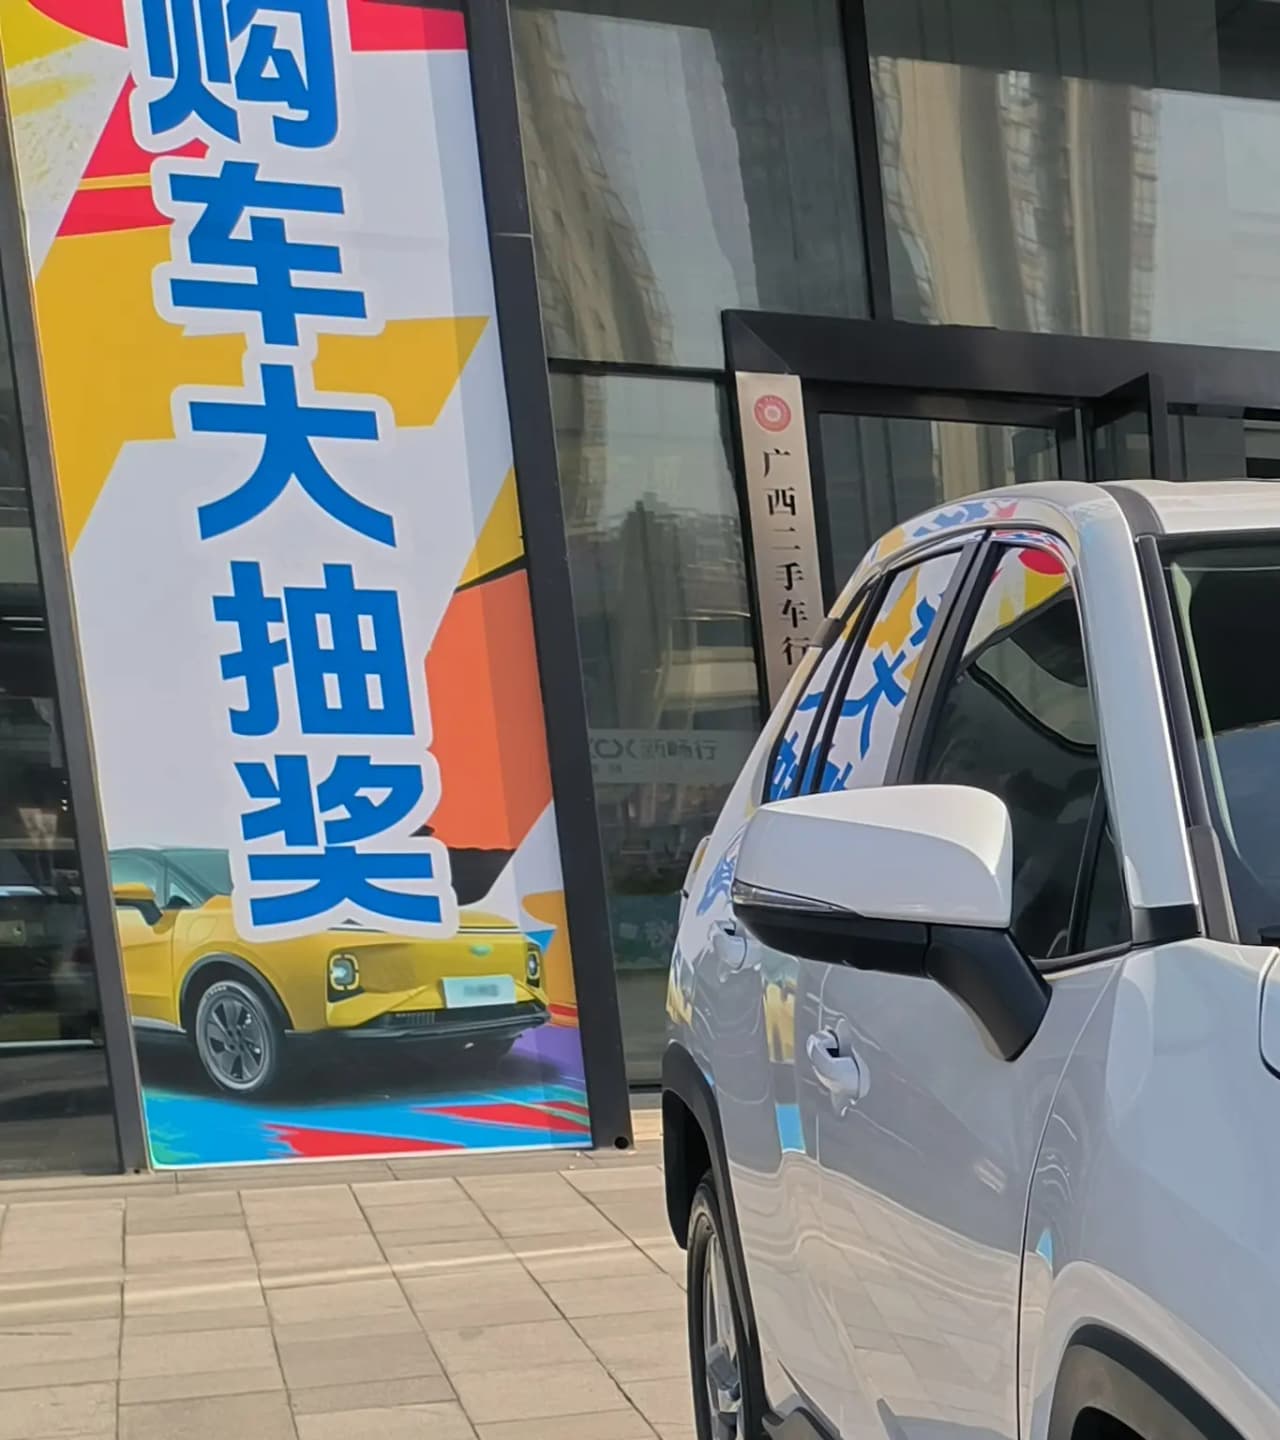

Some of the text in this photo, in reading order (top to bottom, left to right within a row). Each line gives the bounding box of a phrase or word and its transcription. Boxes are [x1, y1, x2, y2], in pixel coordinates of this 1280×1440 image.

[141, 0, 442, 926] 购车大抽奖
[762, 448, 812, 666] 广西二手车行
